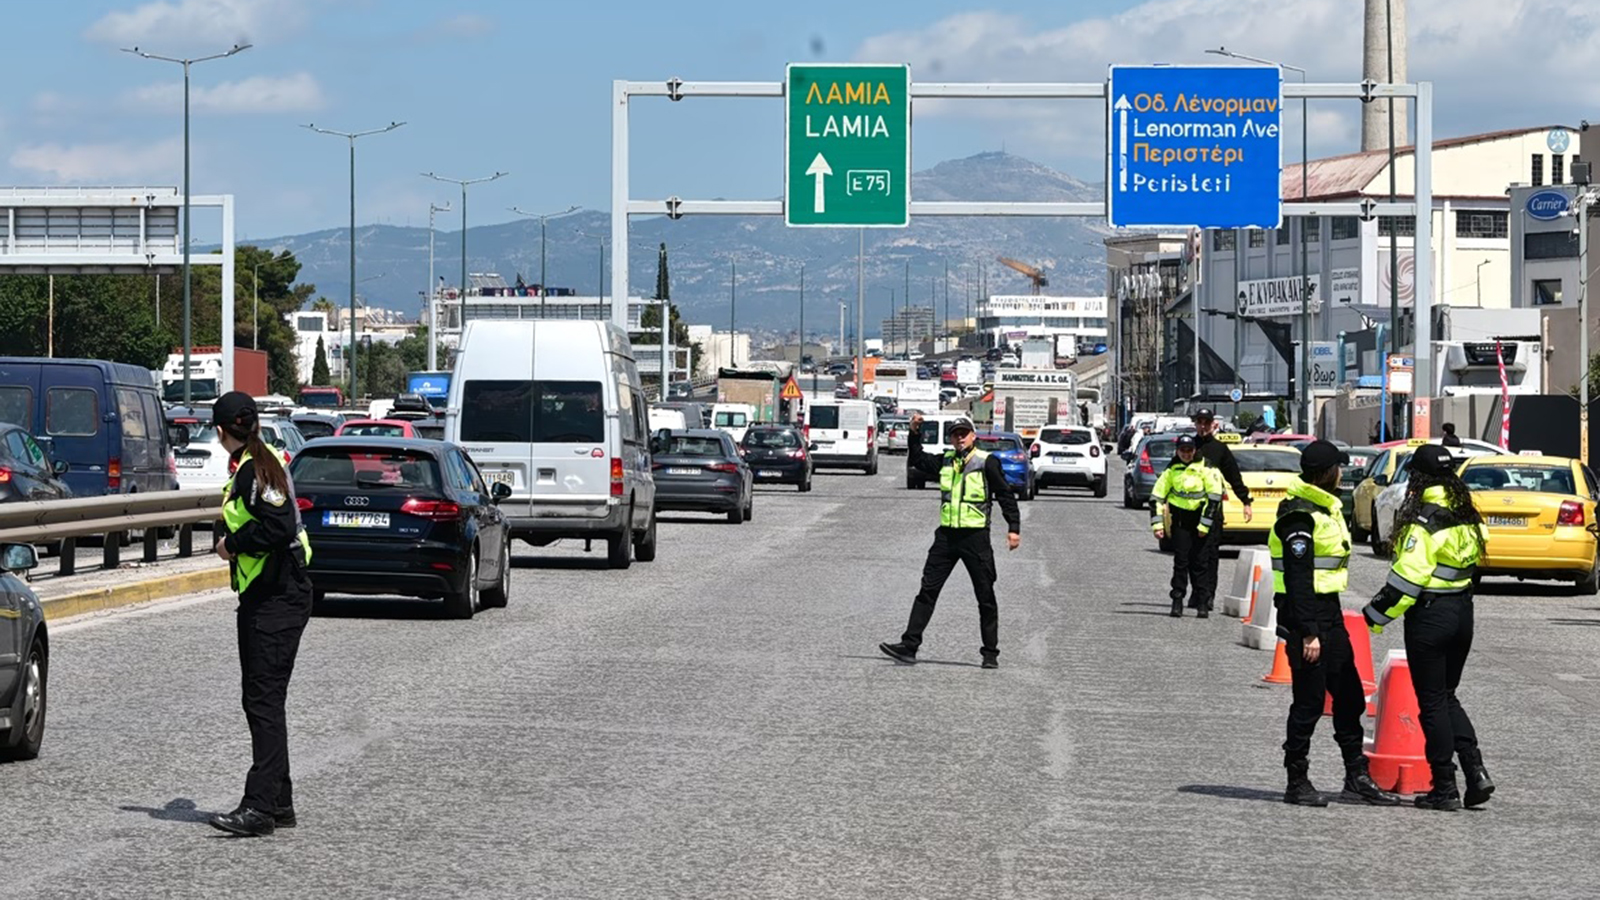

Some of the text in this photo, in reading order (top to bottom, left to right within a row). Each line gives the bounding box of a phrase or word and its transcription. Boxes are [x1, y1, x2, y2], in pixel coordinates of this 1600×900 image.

[805, 81, 891, 105] ΛΑΜΙΑ
[1134, 92, 1277, 117] Οδ. Λένορμαν
[805, 114, 890, 138] LAMIA
[1134, 118, 1279, 138] Lenorman Ave
[1133, 142, 1244, 167] Περιστέρι
[1133, 172, 1230, 192] Peristeri
[1531, 197, 1563, 211] Carrier
